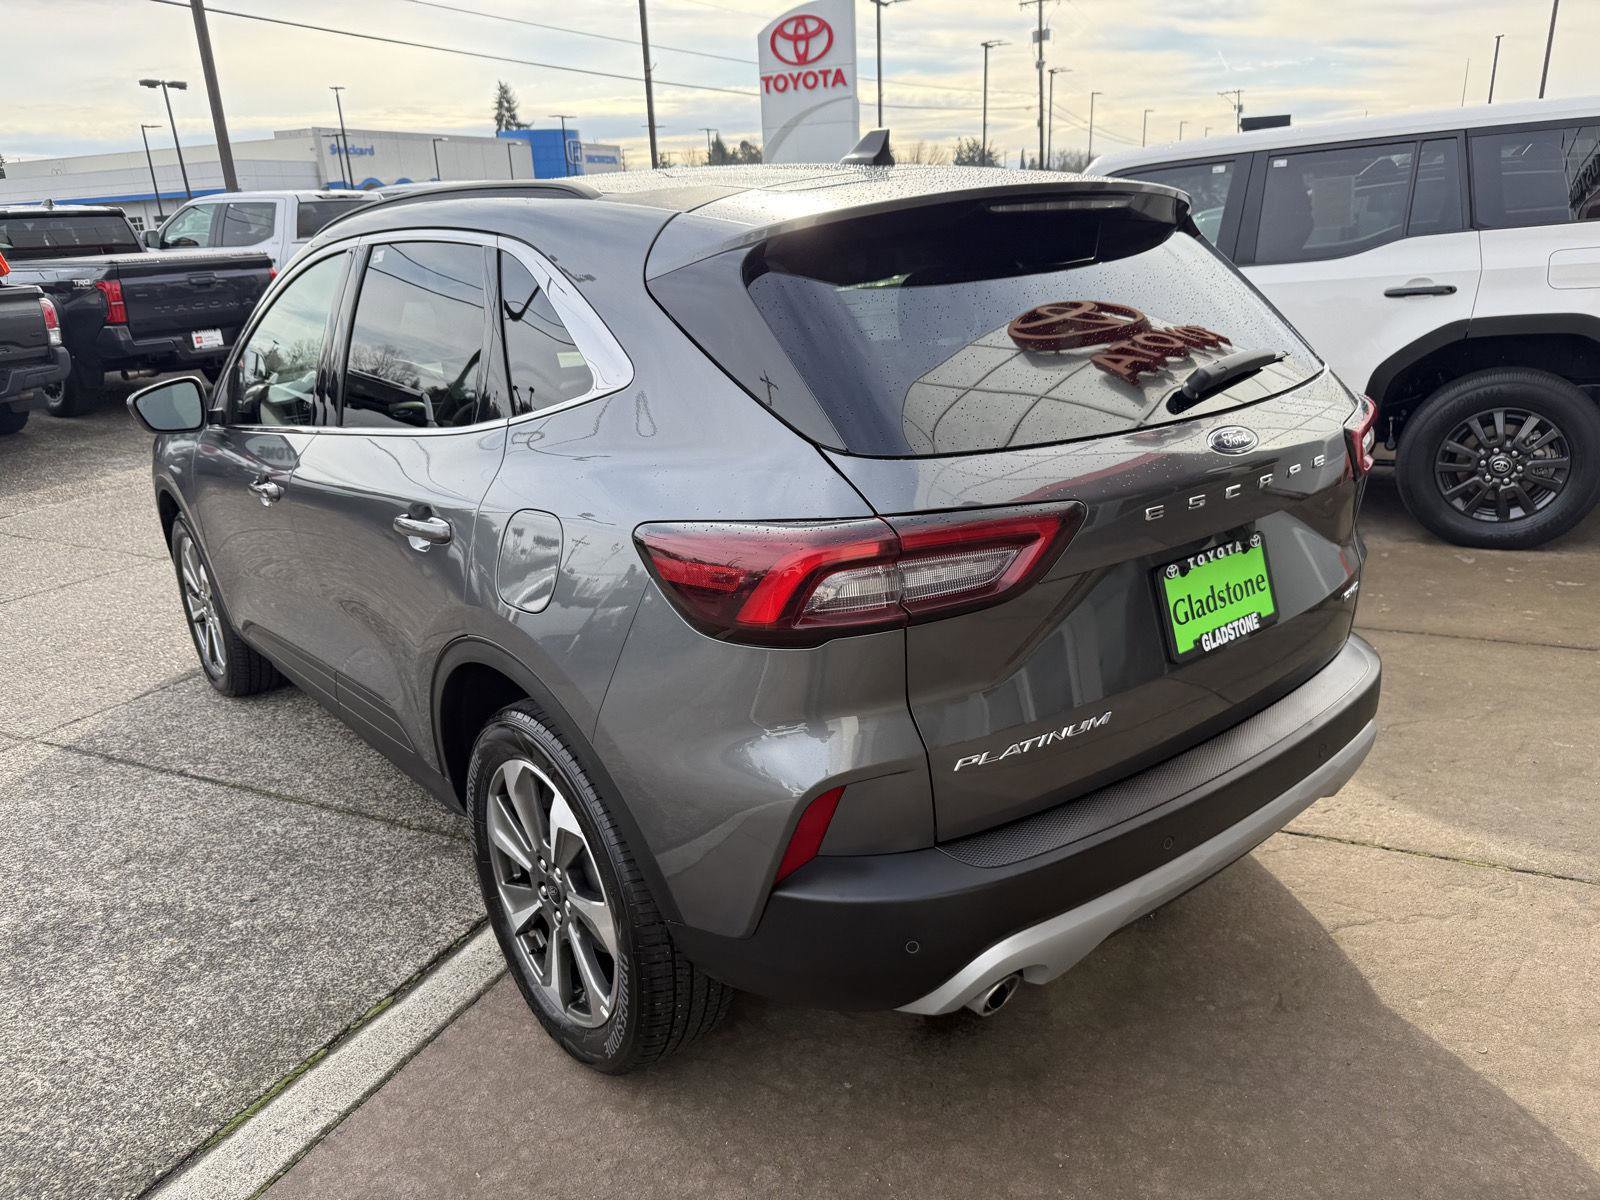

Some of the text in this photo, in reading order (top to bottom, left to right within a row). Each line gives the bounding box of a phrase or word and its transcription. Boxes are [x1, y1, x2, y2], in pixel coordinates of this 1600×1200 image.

[761, 68, 848, 95] TOYOTA
[1221, 430, 1251, 448] Ford
[1145, 455, 1326, 521] ESCAPE
[1187, 541, 1243, 570] TOYOTA
[1172, 573, 1267, 625] Gladstone
[1201, 611, 1261, 652] GLADSTONE
[953, 711, 1113, 772] PLATINUM
